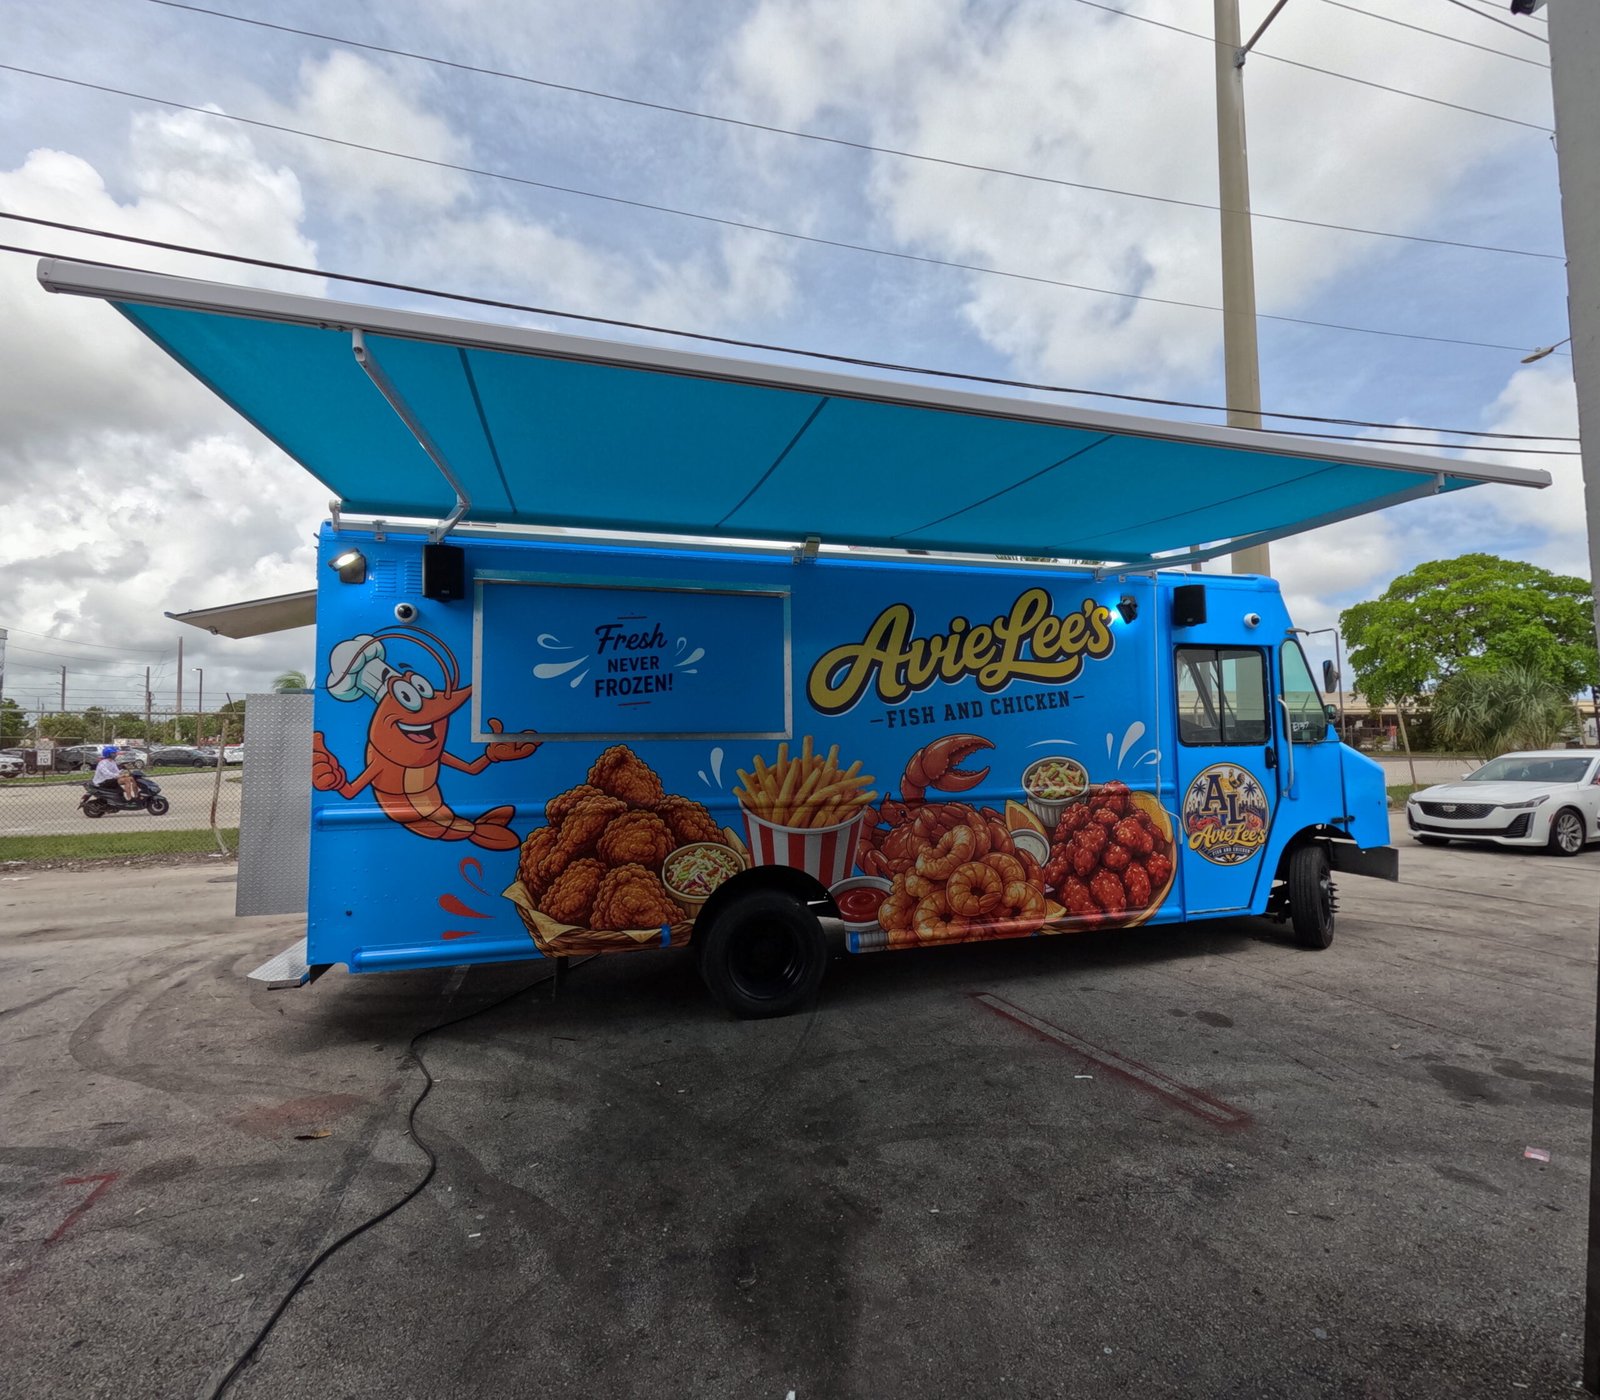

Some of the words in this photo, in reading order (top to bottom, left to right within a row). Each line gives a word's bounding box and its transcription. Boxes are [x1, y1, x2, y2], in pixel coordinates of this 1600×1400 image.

[594, 622, 668, 655] Fresh
[607, 655, 660, 673] NEVER
[594, 673, 674, 698] FROZEN!
[886, 708, 936, 729] FISH
[944, 700, 984, 722] AND
[991, 690, 1071, 716] CHICKEN
